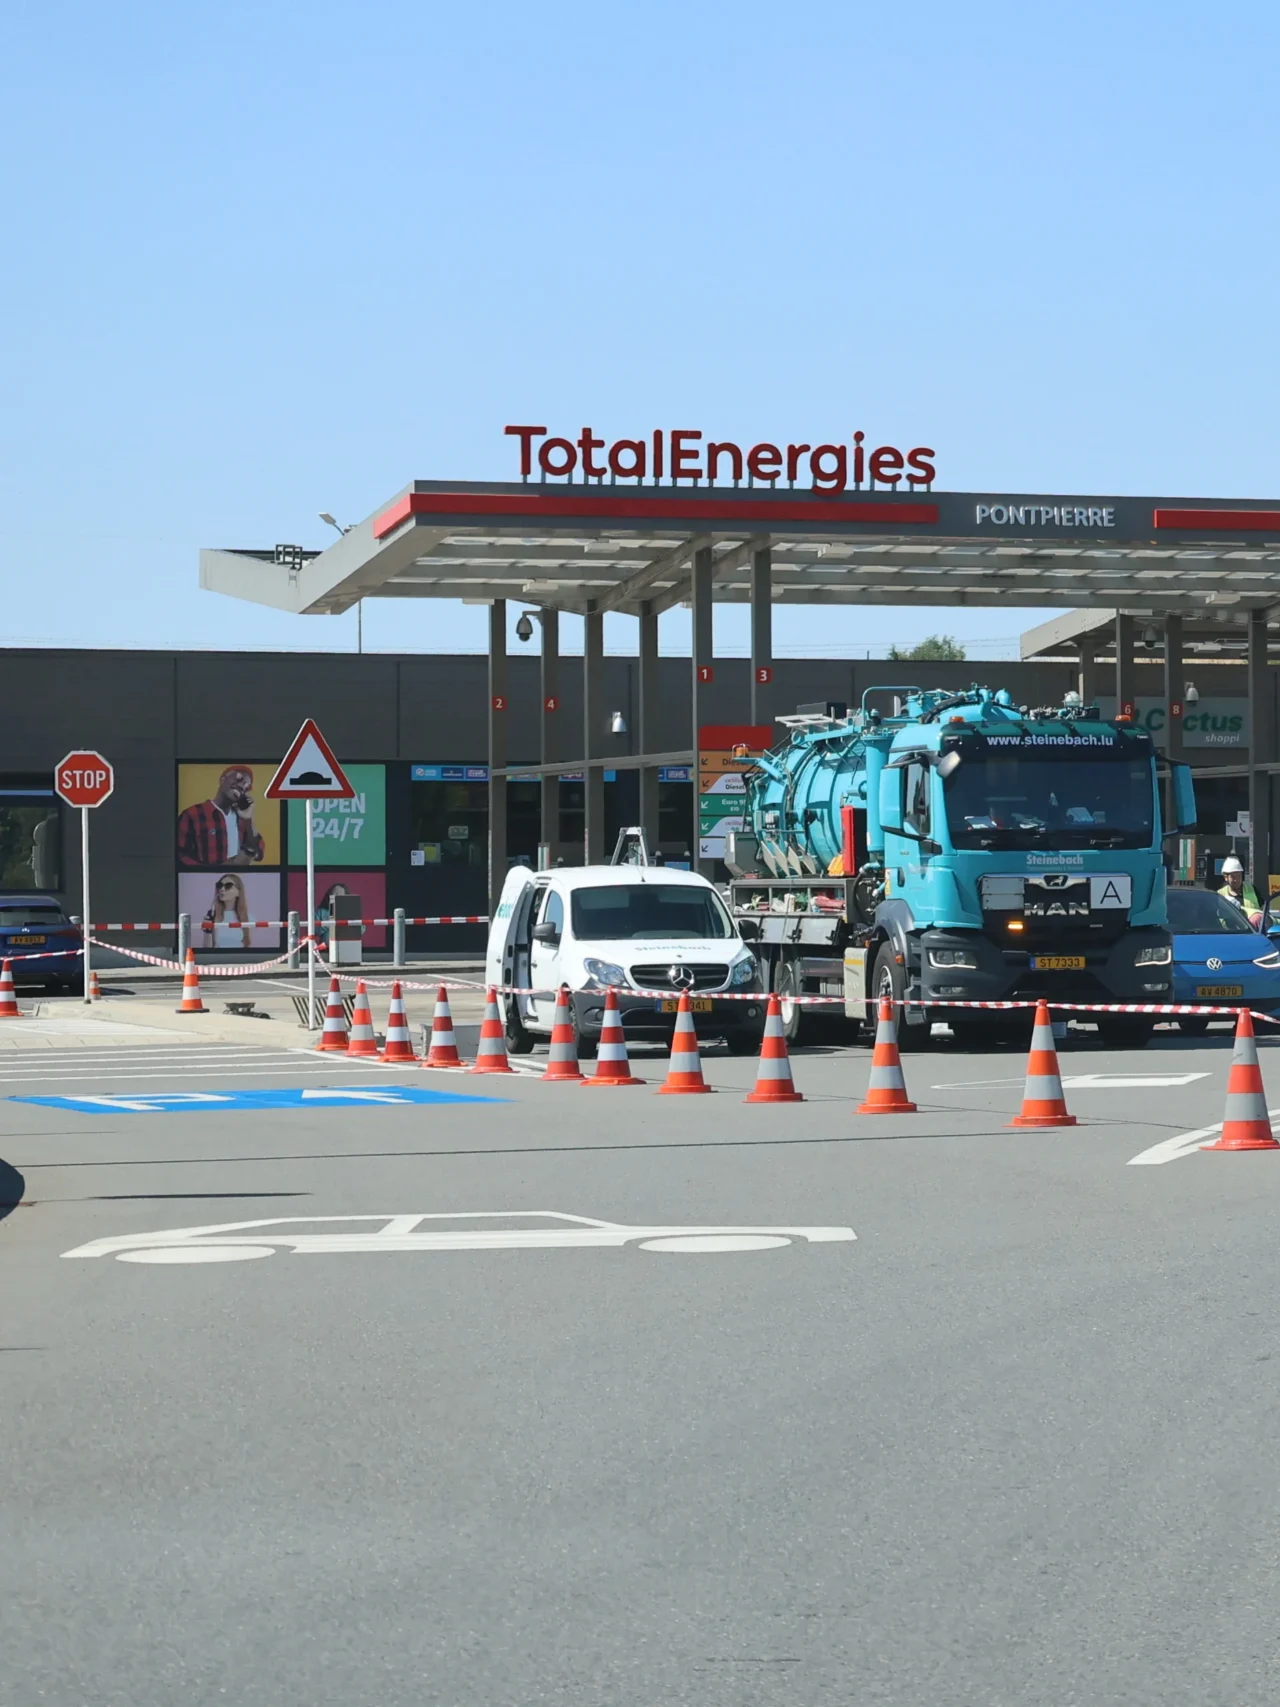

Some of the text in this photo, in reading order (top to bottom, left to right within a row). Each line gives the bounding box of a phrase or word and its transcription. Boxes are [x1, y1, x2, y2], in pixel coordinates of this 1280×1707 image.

[504, 425, 936, 498] TotalEnergies
[974, 504, 1116, 528] PONTPIERRE
[702, 669, 708, 680] 1
[760, 670, 768, 681] 3
[495, 698, 503, 709] 2
[547, 699, 555, 709] 4
[1124, 705, 1132, 715] 6
[1172, 705, 1180, 715] 8
[1144, 708, 1243, 733] Cctus
[987, 734, 1114, 746] www.steinebach.lu
[1205, 733, 1240, 743] shoppi
[62, 770, 106, 790] STOP
[312, 817, 364, 842] 24/7
[1026, 854, 1084, 865] Steinebach
[1100, 880, 1123, 904] A
[1024, 902, 1089, 916] MAN
[1040, 957, 1052, 968] ST
